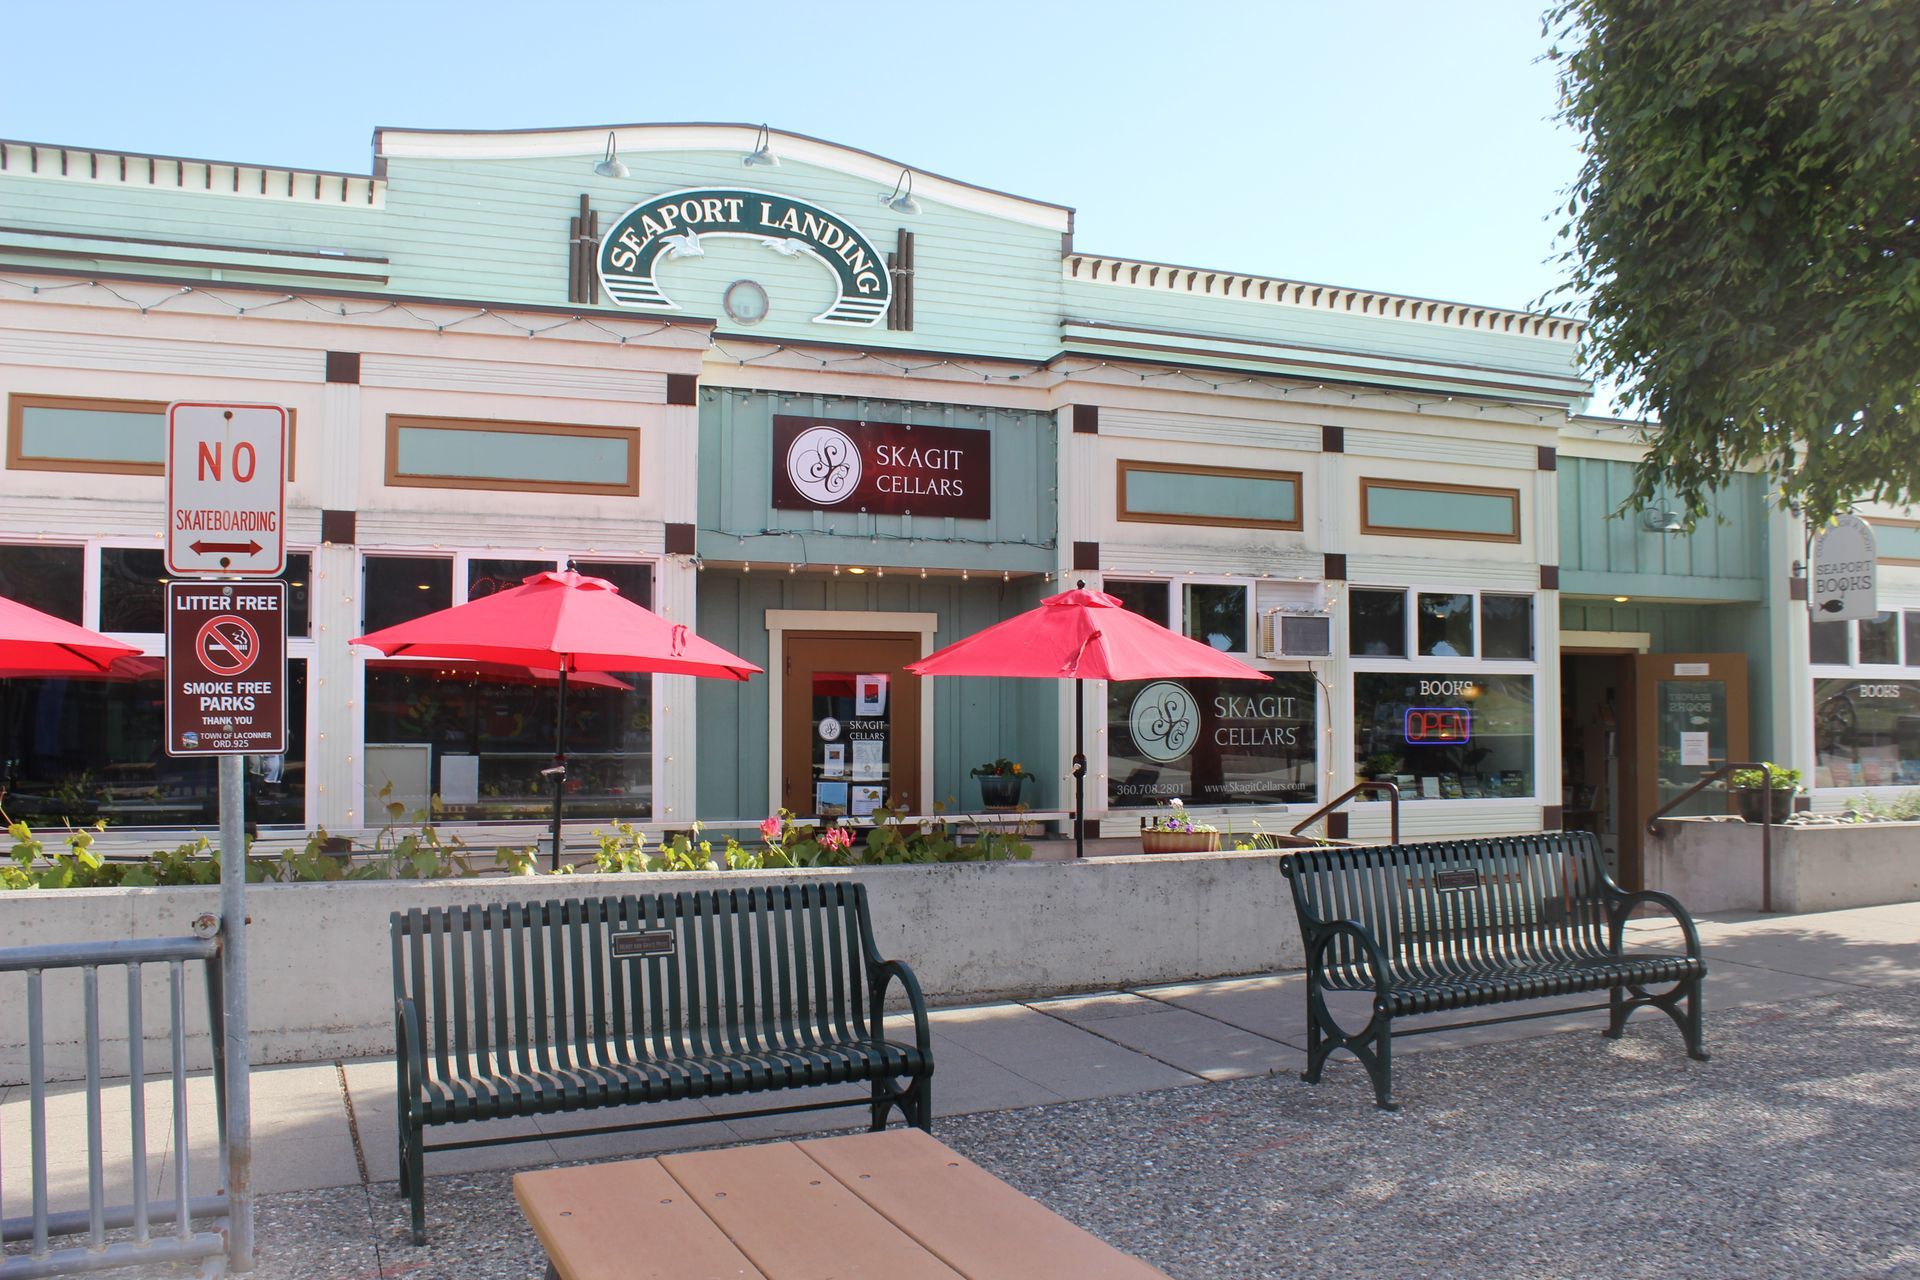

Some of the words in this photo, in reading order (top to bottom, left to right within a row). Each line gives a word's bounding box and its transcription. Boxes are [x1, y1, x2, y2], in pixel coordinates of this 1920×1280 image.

[611, 198, 743, 272] SEAPORT
[760, 201, 881, 294] LANDING
[198, 441, 256, 483] NO
[876, 445, 964, 470] SKAGIT
[876, 475, 964, 497] CELLARS
[176, 509, 276, 532] SKATEBOARDING
[1816, 560, 1872, 576] SEAPORT
[1816, 575, 1873, 594] BOOKS
[176, 595, 231, 611] LITTER
[236, 596, 278, 611] FREE
[183, 682, 233, 695] SMOKE
[237, 681, 272, 694] FREE
[1860, 684, 1900, 698] BOOKS
[200, 696, 256, 712] PARKS
[1214, 697, 1296, 719] SKAGIT
[202, 716, 232, 725] THANK
[234, 716, 253, 725] YOU
[849, 720, 885, 730] SKAGIT
[1408, 711, 1469, 740] OPEN
[200, 732, 222, 740] TOWN
[849, 732, 885, 740] CELLARS
[1214, 727, 1296, 746] CELLARS
[1116, 783, 1185, 796] 360.708.2801
[1204, 780, 1306, 794] www.SkagitCellars.com
